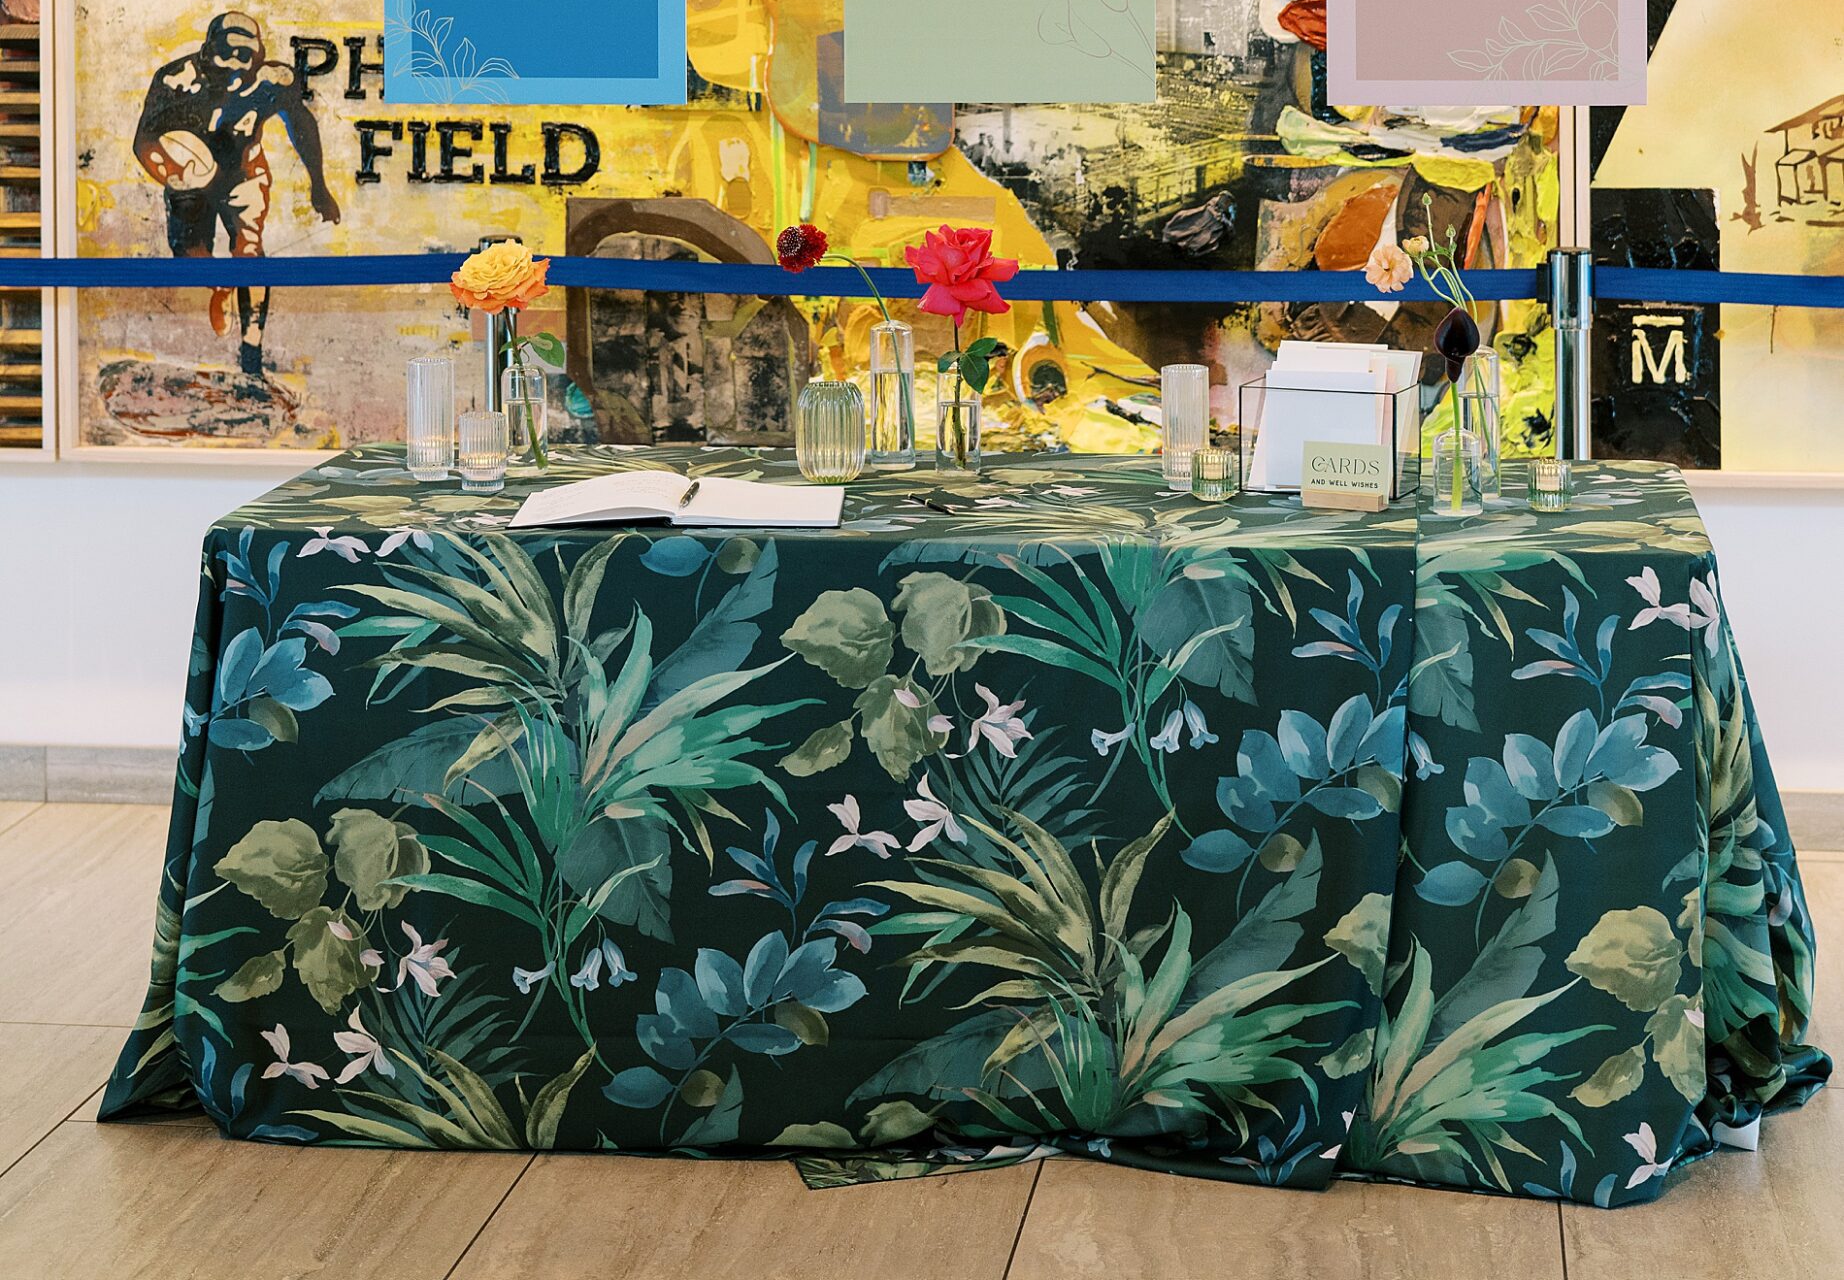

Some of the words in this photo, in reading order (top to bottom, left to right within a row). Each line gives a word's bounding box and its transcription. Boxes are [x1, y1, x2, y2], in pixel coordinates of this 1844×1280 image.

[354, 119, 601, 187] FIELD
[1311, 455, 1381, 476] CARDS
[1328, 479, 1348, 487] WELL
[1351, 480, 1379, 489] WISHES
